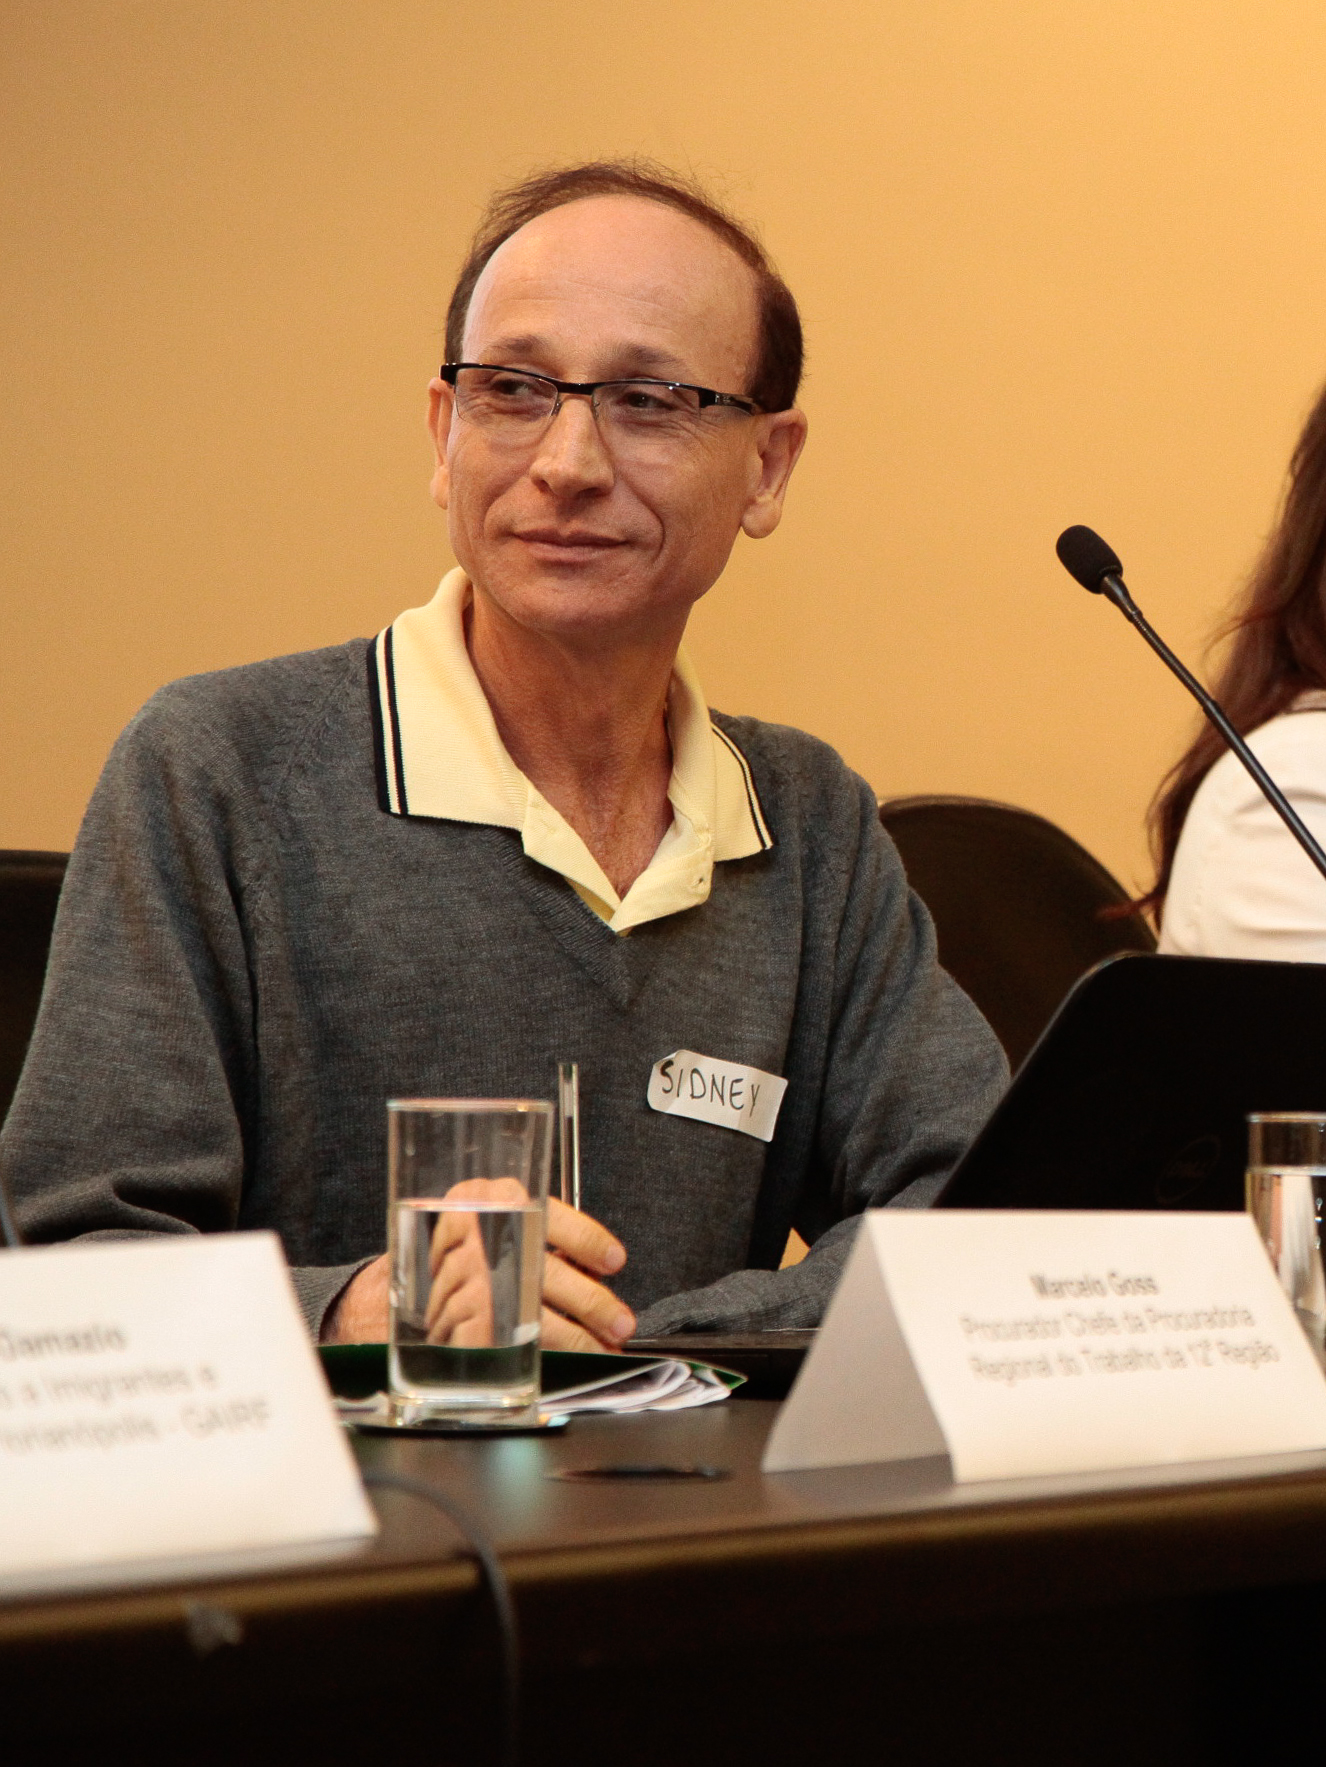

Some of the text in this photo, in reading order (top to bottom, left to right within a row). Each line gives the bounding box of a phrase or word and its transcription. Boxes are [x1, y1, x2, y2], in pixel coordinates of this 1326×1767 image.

[660, 1060, 760, 1117] SIDNEY
[1030, 1274, 1107, 1298] Marcelo
[960, 1305, 1255, 1341] Procurador Chefe da Procuradoria
[970, 1355, 1052, 1386] Regional
[1057, 1352, 1081, 1375] do
[1081, 1348, 1161, 1372] Trabalho
[1163, 1346, 1187, 1368] da
[1217, 1340, 1280, 1369] Região
